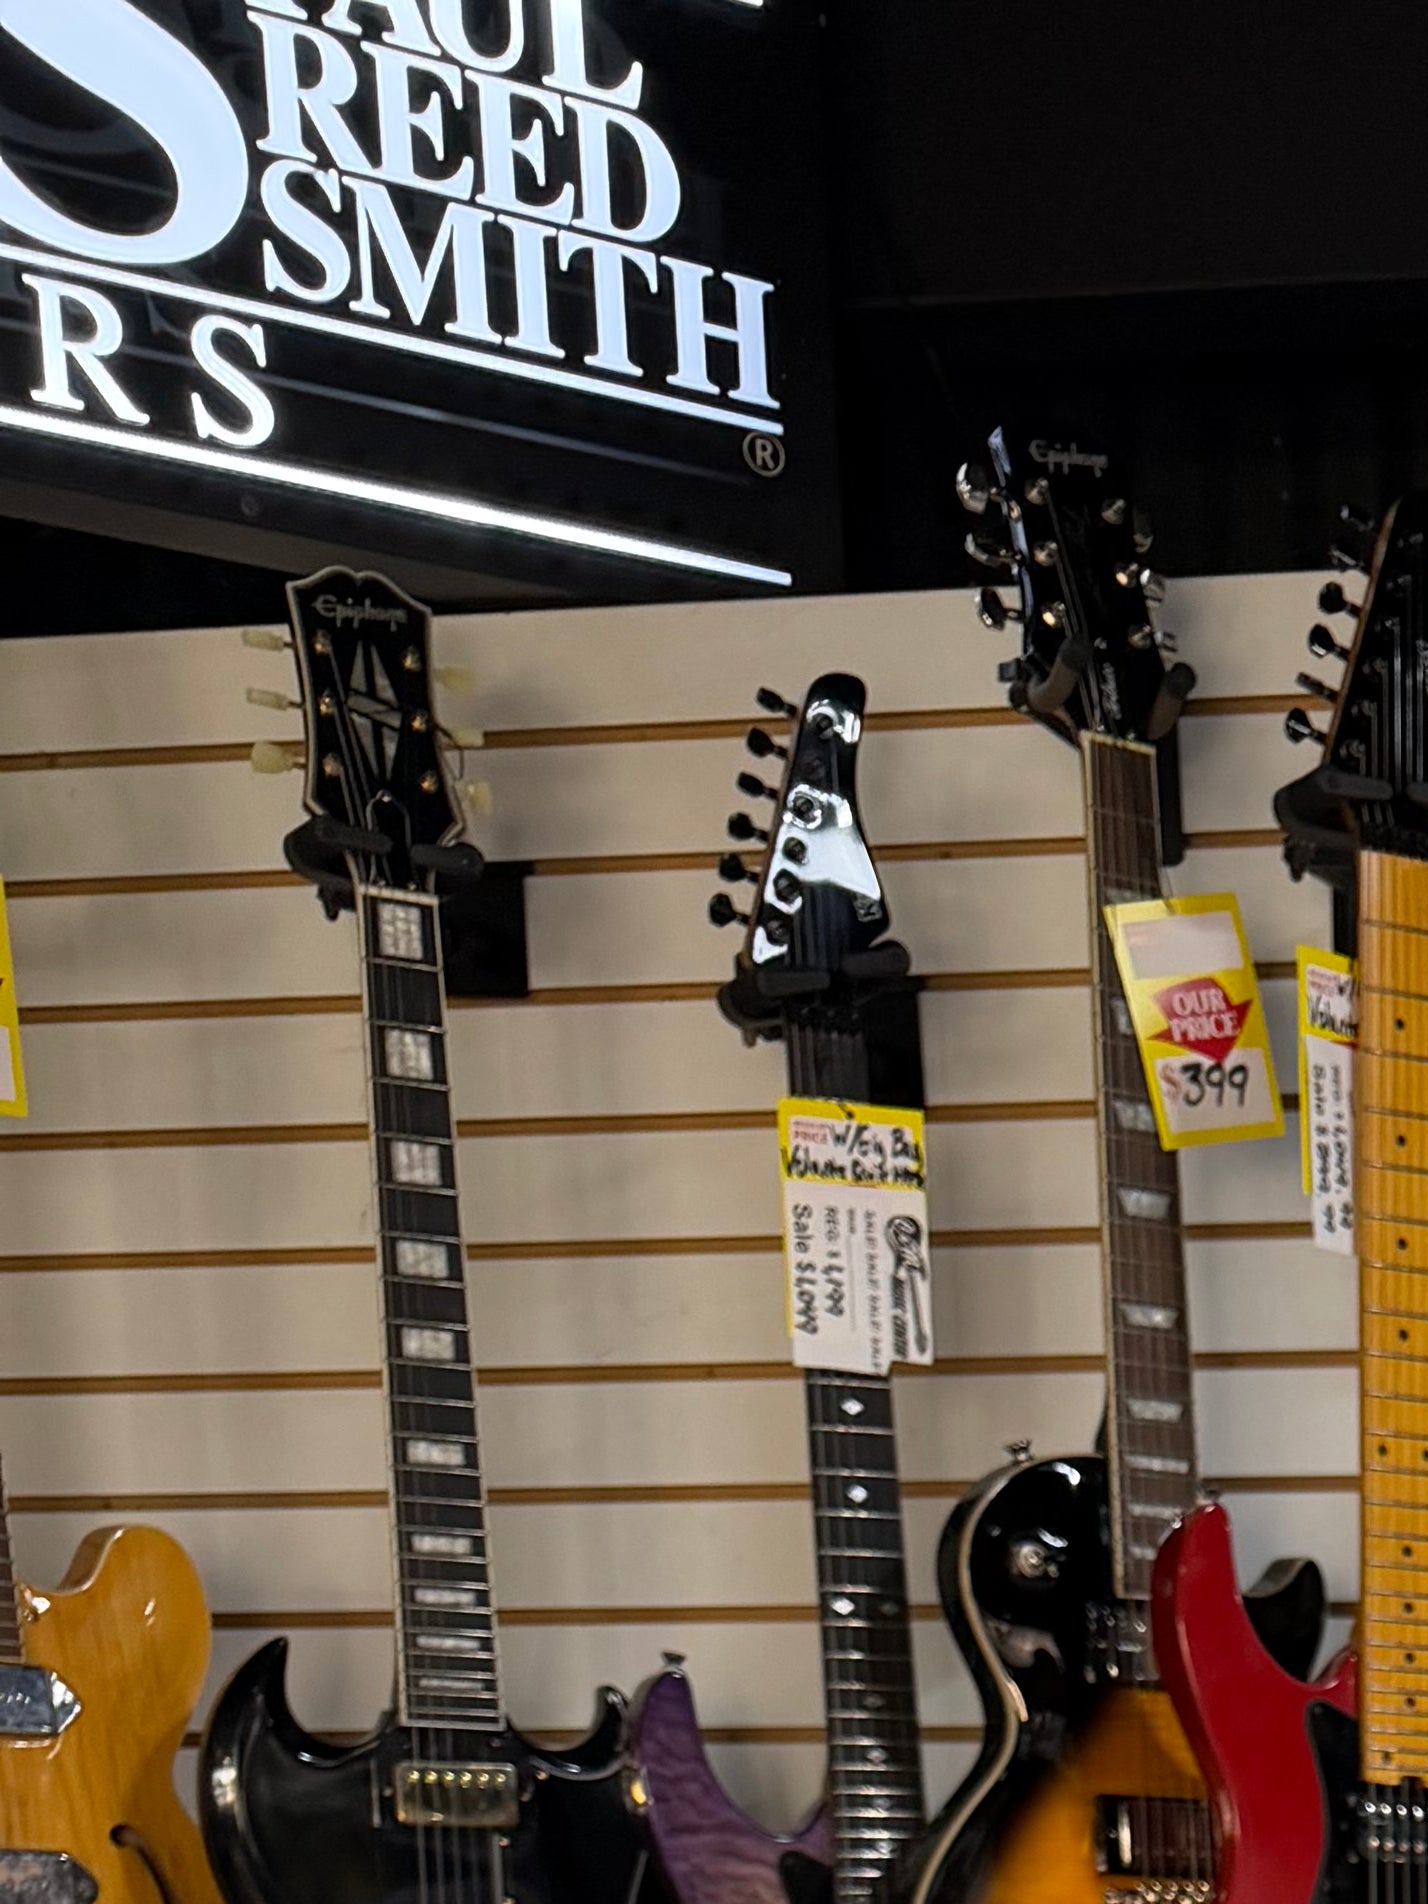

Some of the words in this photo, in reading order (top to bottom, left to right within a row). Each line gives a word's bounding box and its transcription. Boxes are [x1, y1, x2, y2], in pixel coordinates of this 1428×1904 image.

[247, 10, 682, 243] REED
[259, 158, 781, 409] SMITH
[1173, 987, 1226, 1017] OUR
[1169, 1011, 1241, 1043] PRICE
[1159, 1063, 1249, 1108] $399
[792, 1203, 815, 1254] Sale
